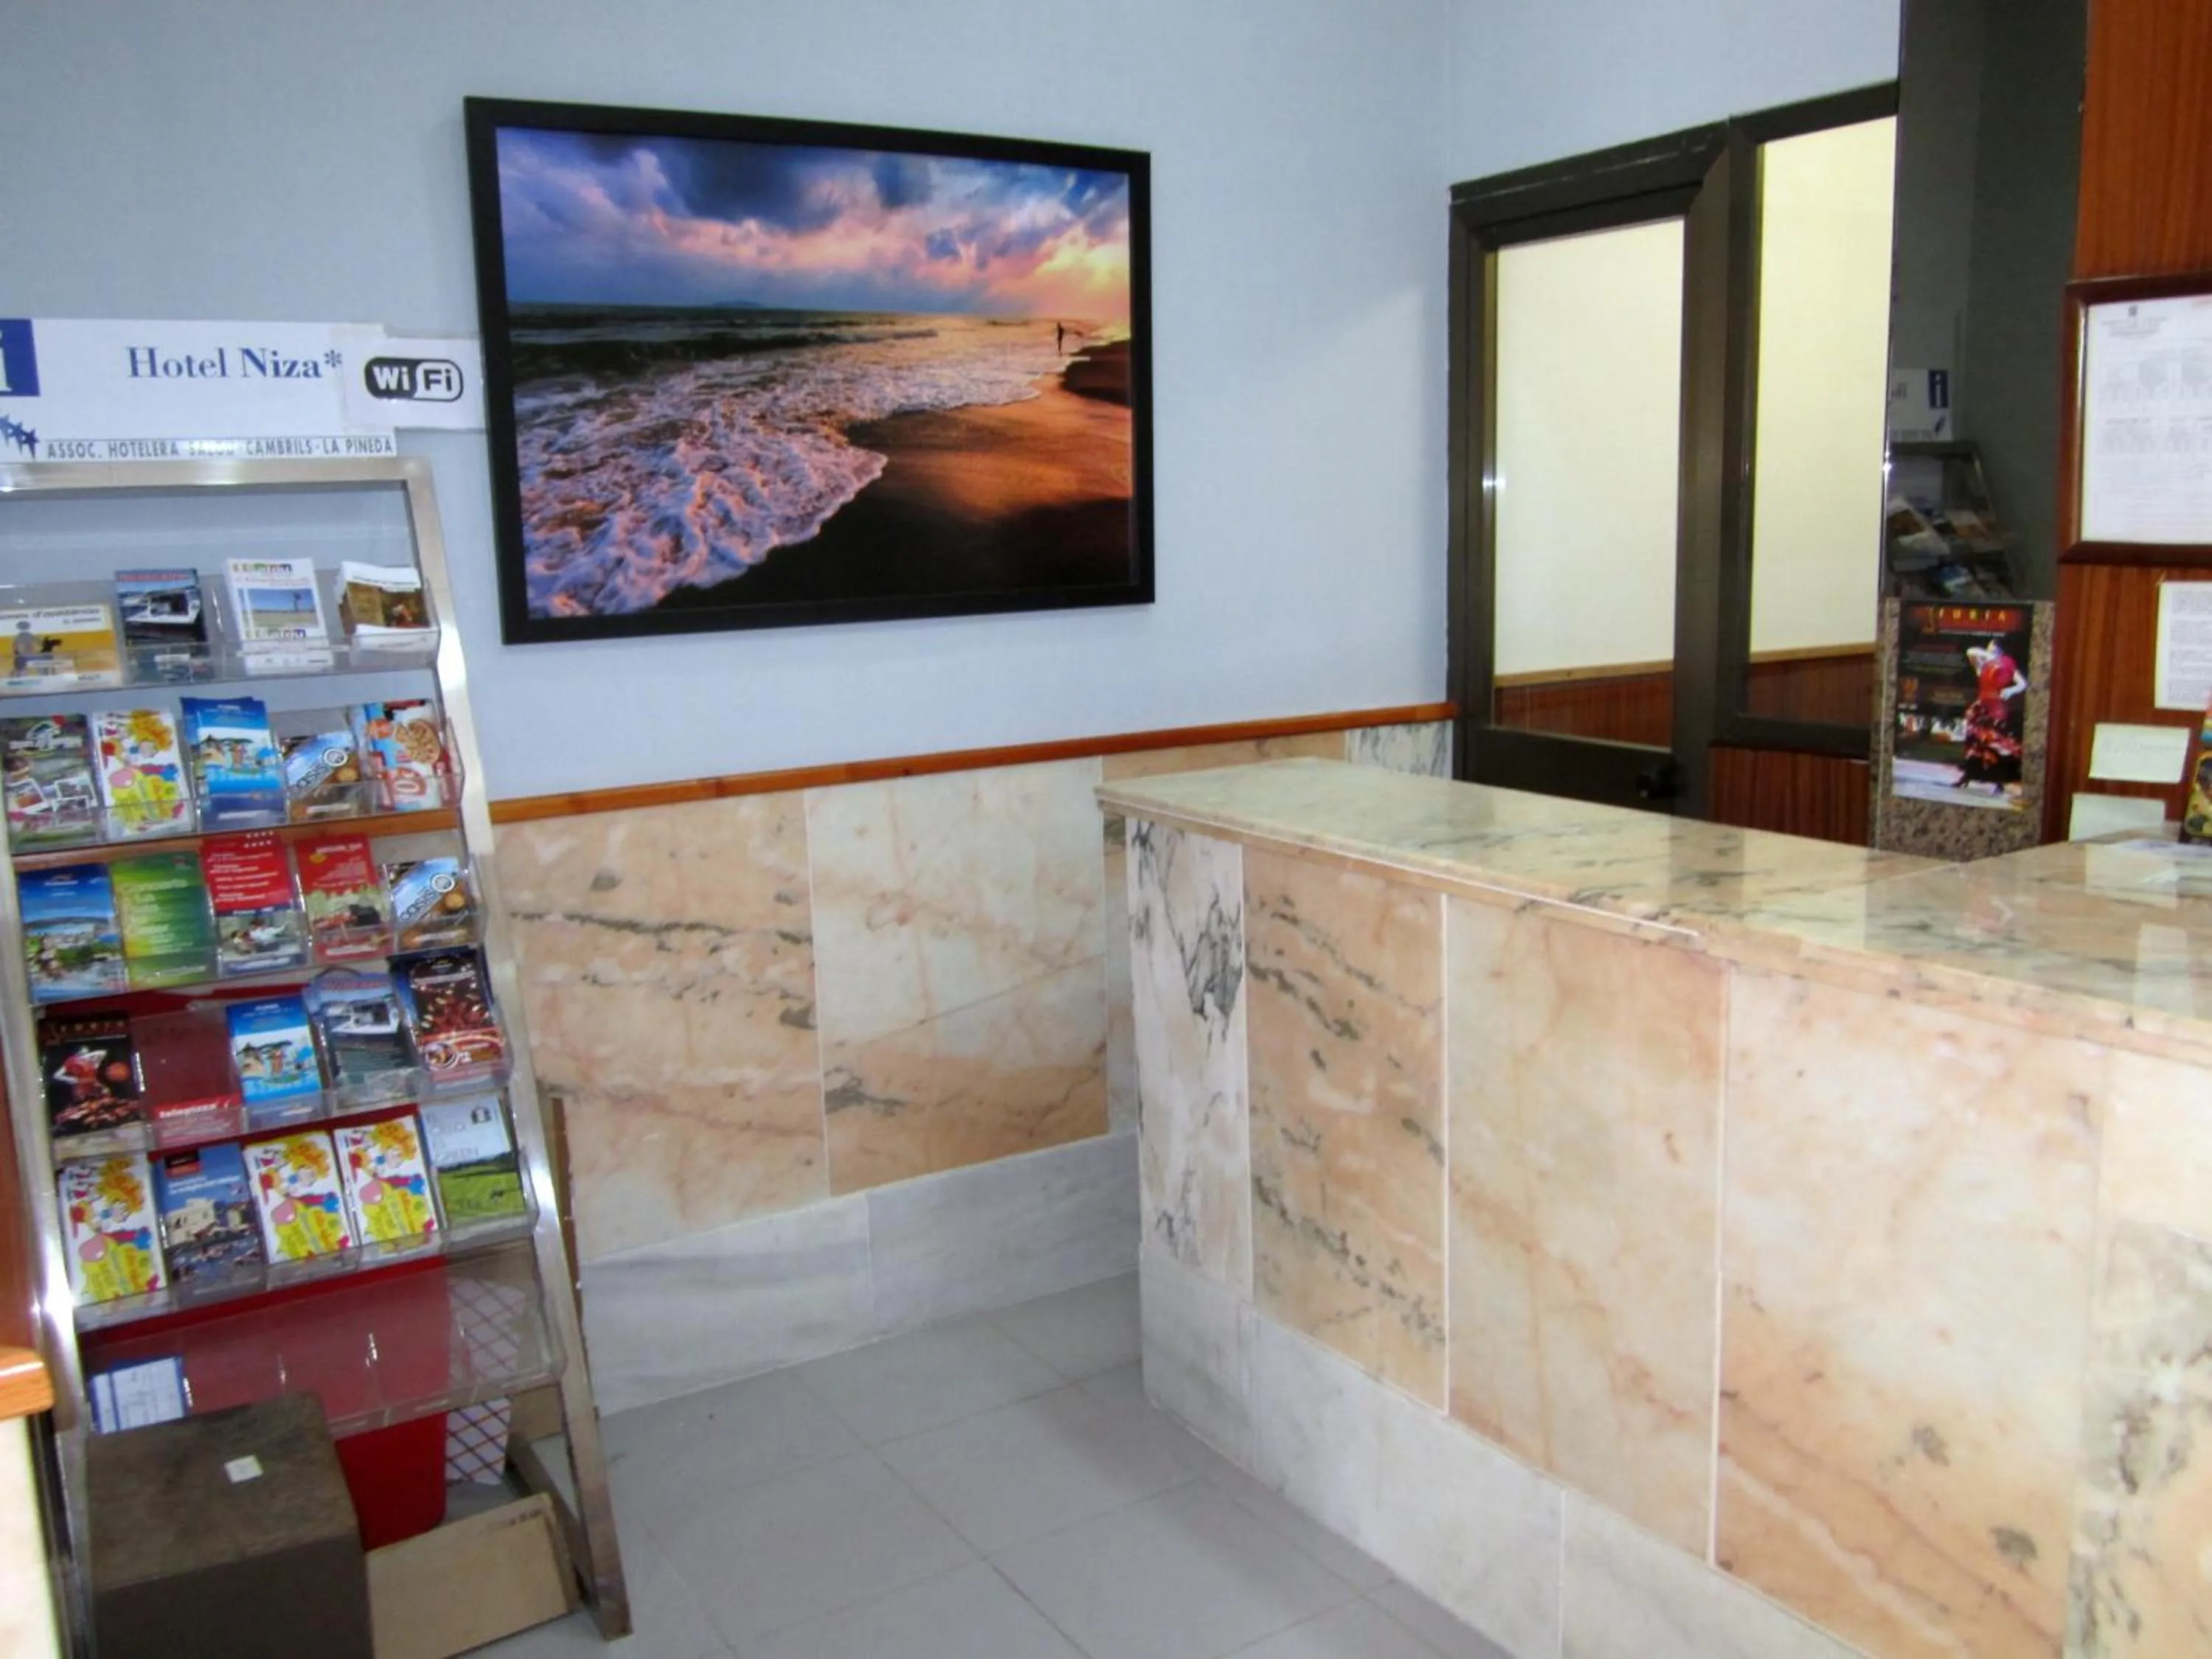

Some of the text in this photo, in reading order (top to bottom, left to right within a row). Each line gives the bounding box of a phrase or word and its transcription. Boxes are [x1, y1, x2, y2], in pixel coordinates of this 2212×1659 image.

[126, 347, 229, 378] Hotel
[47, 442, 102, 459] ASSOC.
[108, 441, 179, 458] HOTELERA
[345, 438, 393, 454] PINEDA
